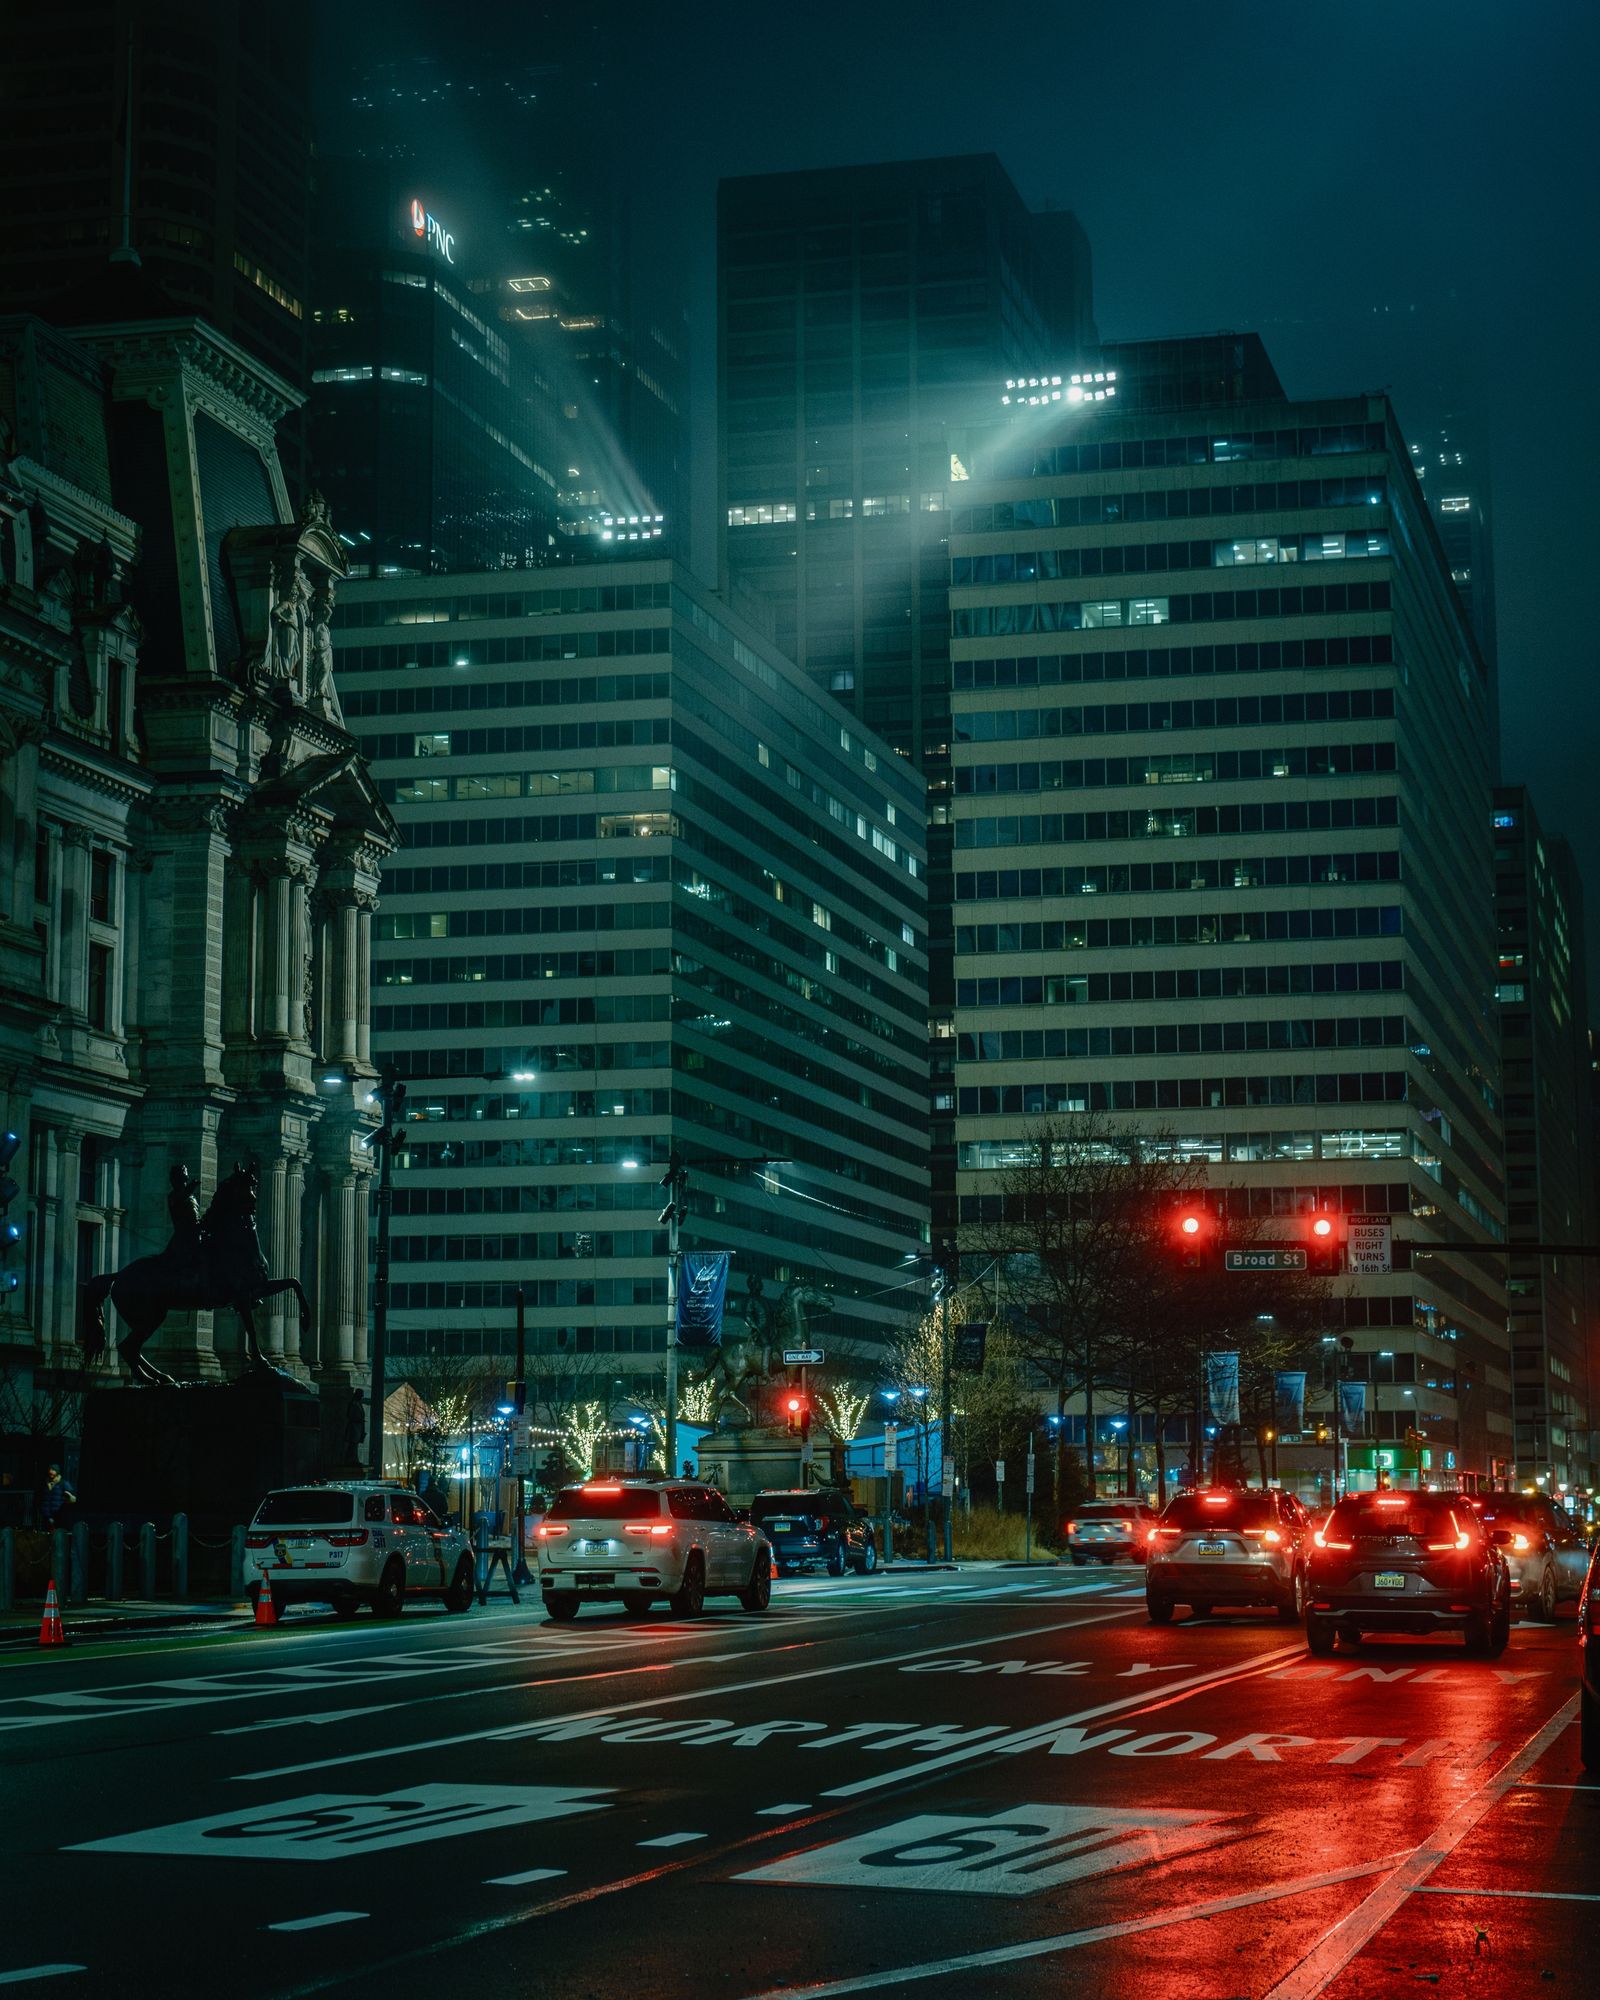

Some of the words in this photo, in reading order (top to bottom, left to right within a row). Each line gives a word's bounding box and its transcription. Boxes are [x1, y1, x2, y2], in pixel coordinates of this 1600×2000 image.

[426, 213, 454, 264] PNC
[1350, 1216, 1369, 1224] RIGHT
[1354, 1228, 1385, 1237] BUSES
[1355, 1241, 1384, 1250] RIGHT
[1232, 1253, 1276, 1266] Broad
[1283, 1253, 1300, 1265] St
[1353, 1252, 1385, 1261] TURNS
[1349, 1264, 1359, 1273] To
[1361, 1264, 1379, 1273] 16th
[1382, 1264, 1391, 1273] St
[897, 1658, 1198, 1678] ONLY
[1268, 1665, 1553, 1685] ONLY
[487, 1716, 1011, 1751] NORTH
[995, 1728, 1502, 1768] NORTH
[201, 1801, 528, 1843] 611
[858, 1824, 1156, 1874] 611
